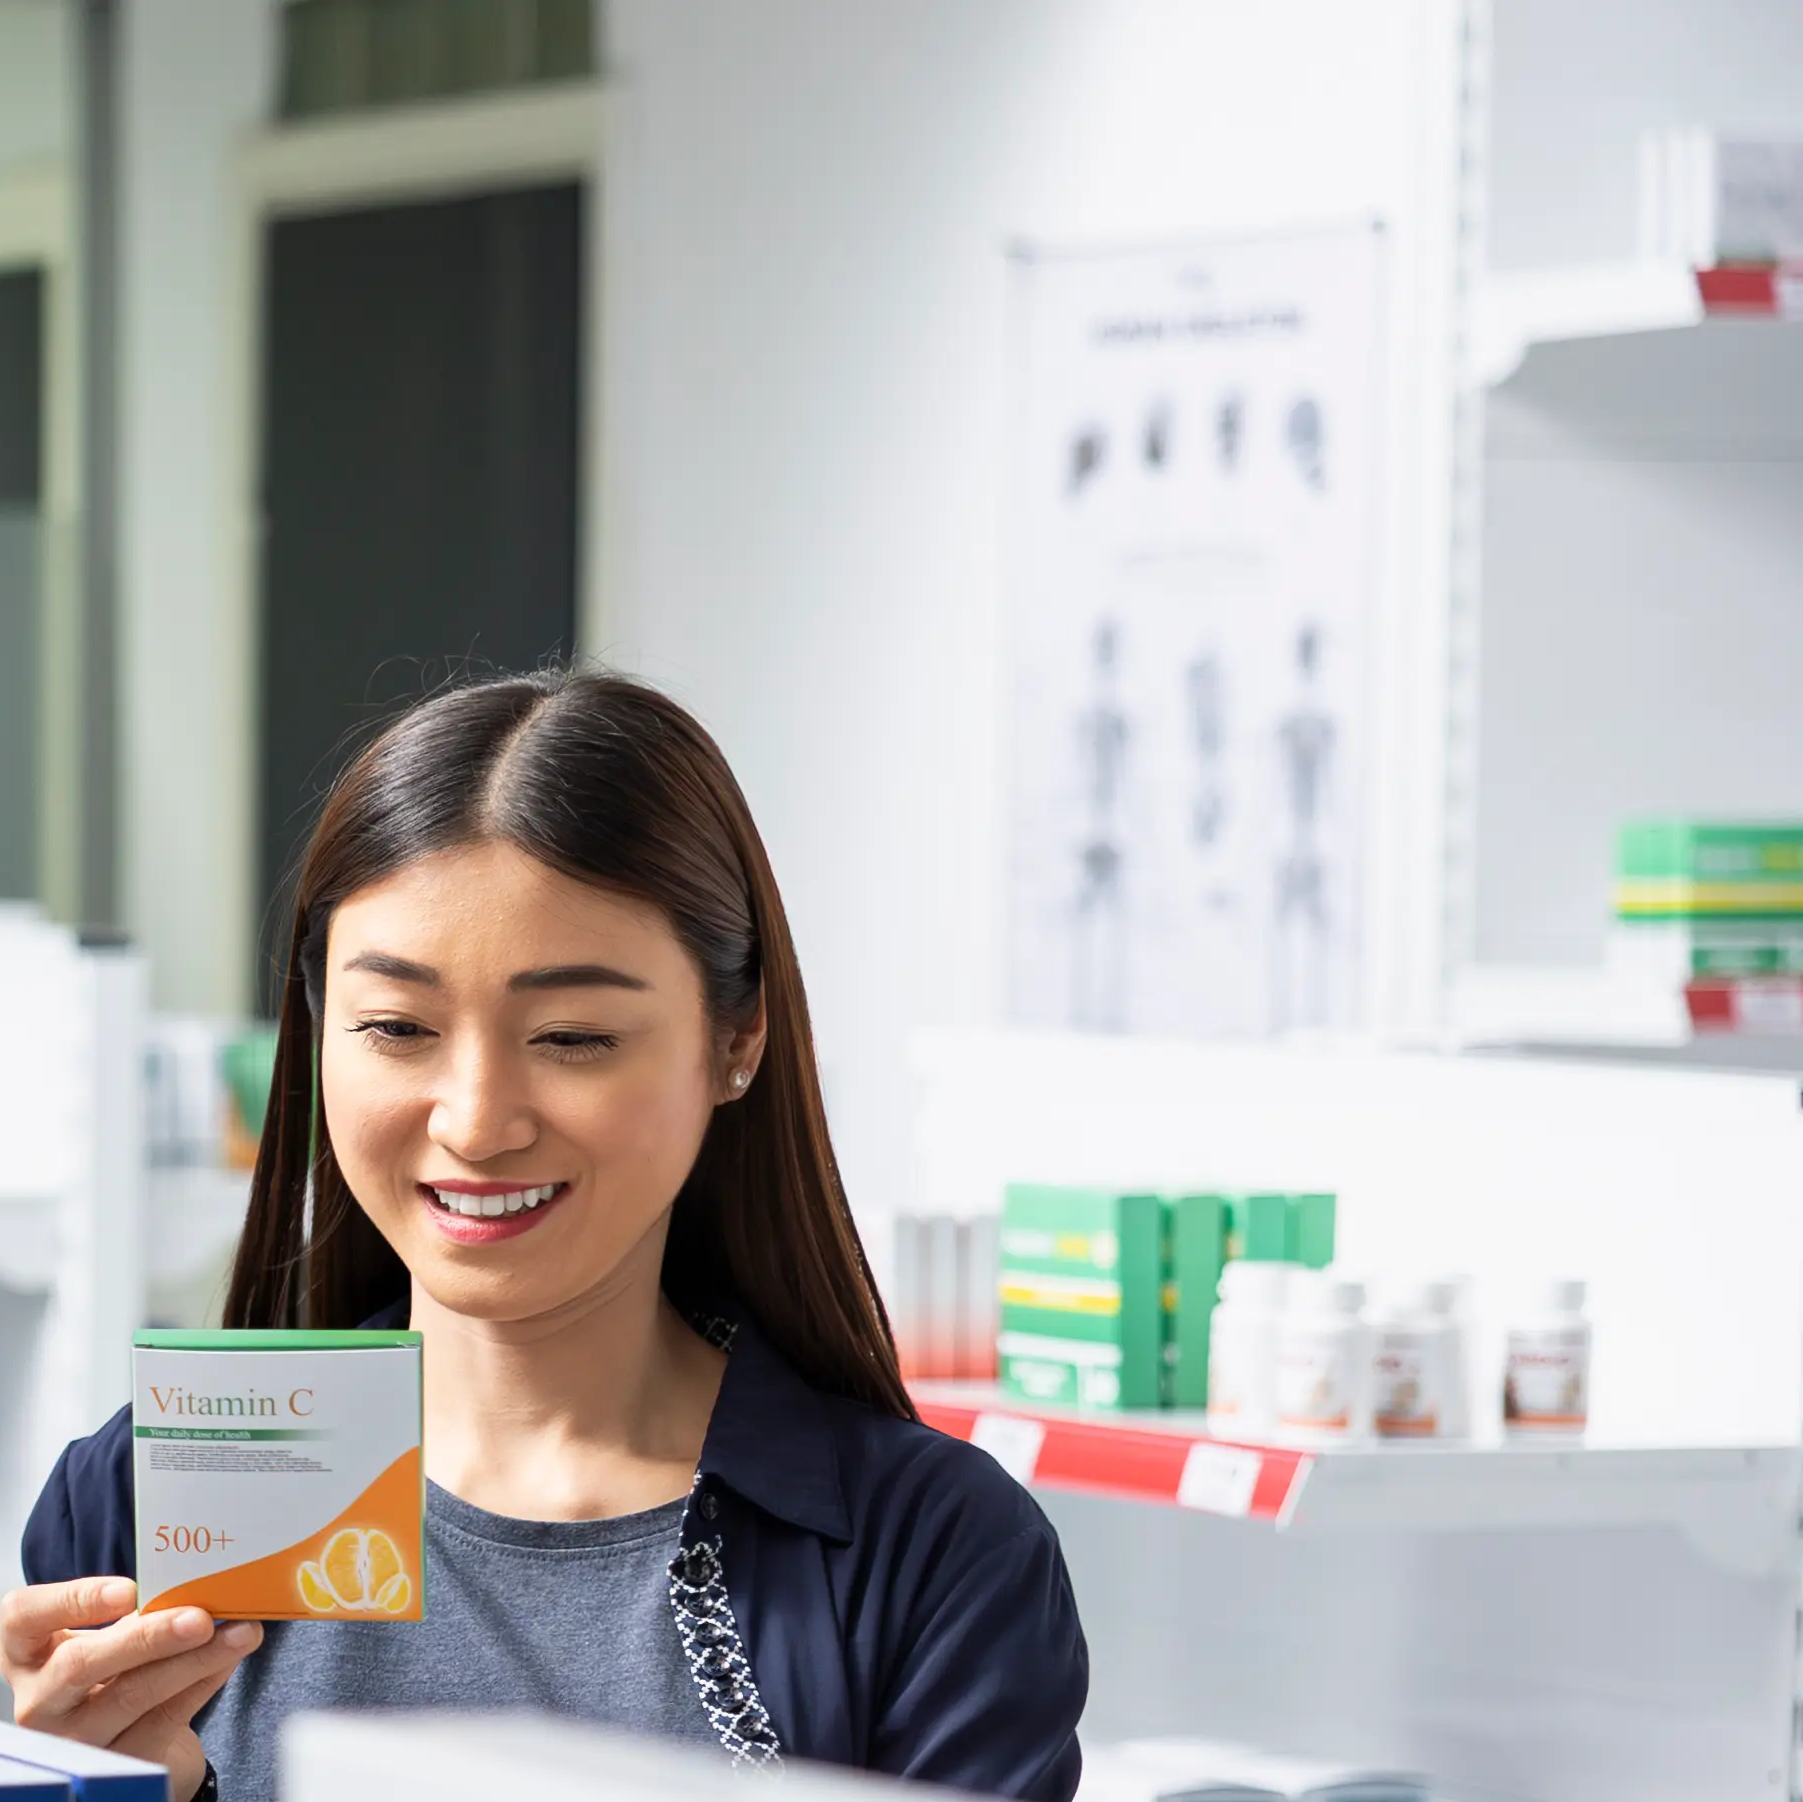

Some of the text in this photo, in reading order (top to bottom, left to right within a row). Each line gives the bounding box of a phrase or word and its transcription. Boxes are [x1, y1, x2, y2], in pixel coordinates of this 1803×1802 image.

[149, 1386, 314, 1416] Vitamin C
[149, 1428, 251, 1440] Your daily dose of health
[154, 1526, 235, 1553] 500+
